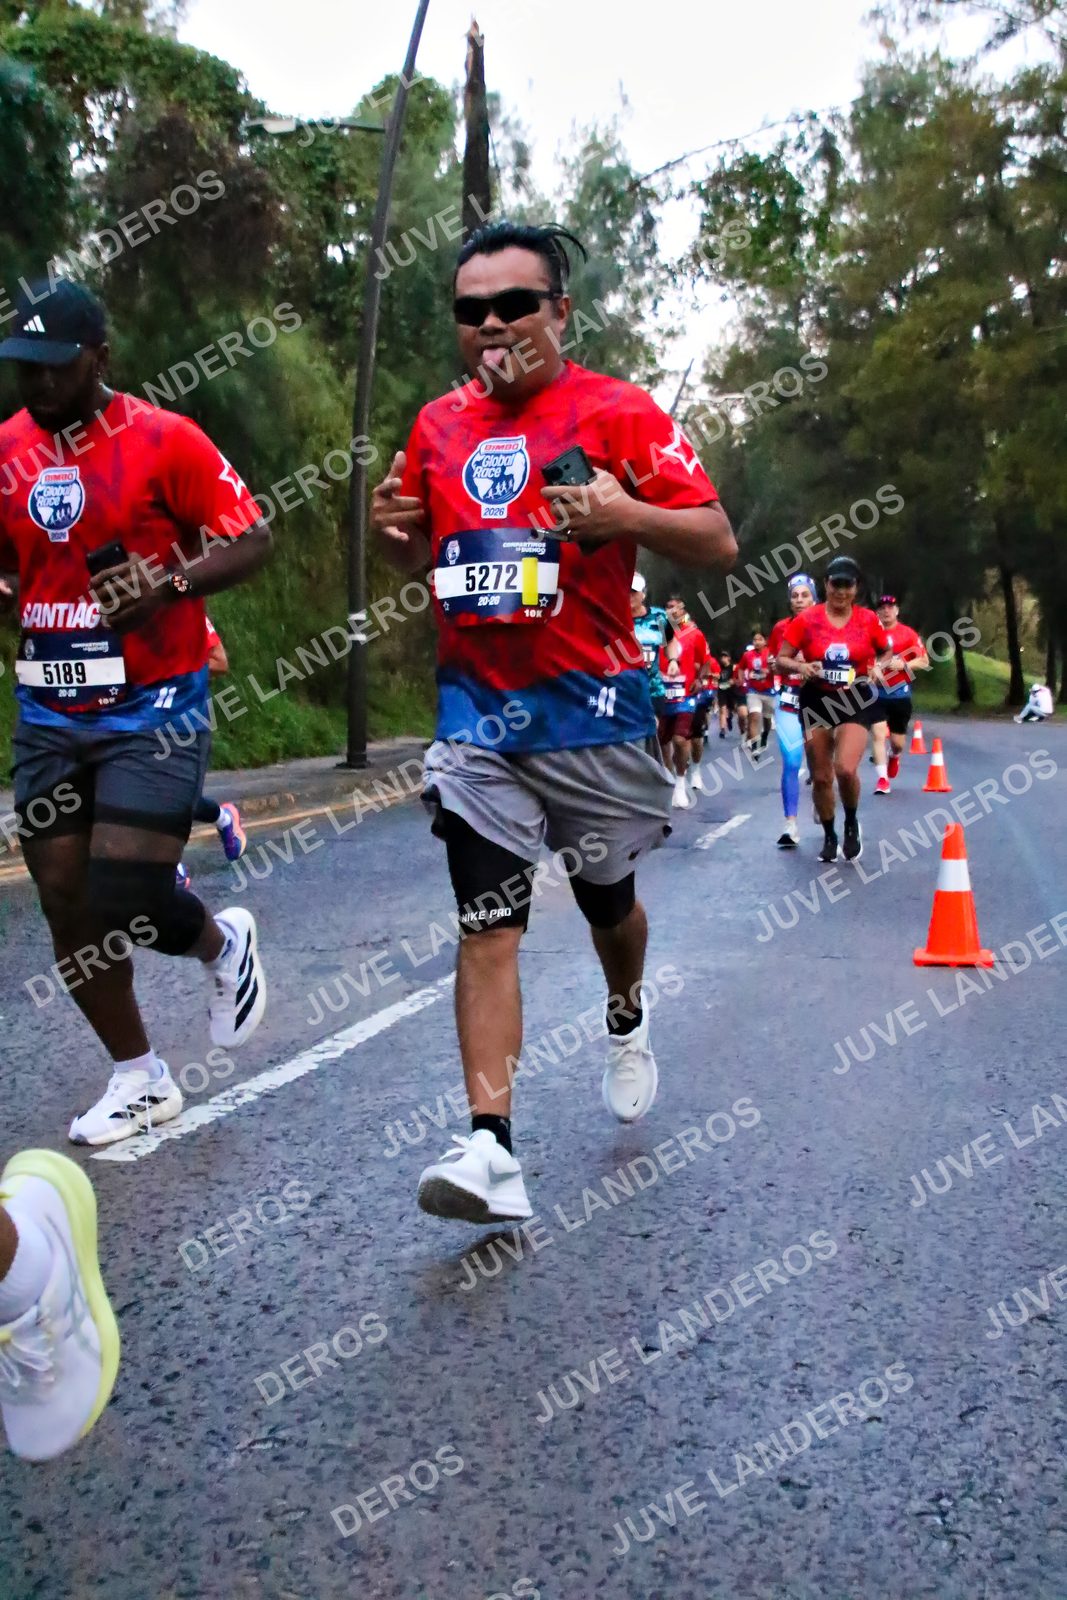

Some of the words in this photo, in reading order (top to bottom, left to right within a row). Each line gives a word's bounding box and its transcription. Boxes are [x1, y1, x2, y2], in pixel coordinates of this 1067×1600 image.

[481, 453, 516, 468] Global
[472, 465, 502, 479] Race
[483, 507, 505, 517] 2026
[465, 564, 518, 592] 5272
[42, 662, 87, 685] 5189
[461, 910, 486, 923] NIKE
[489, 907, 512, 919] PRO
